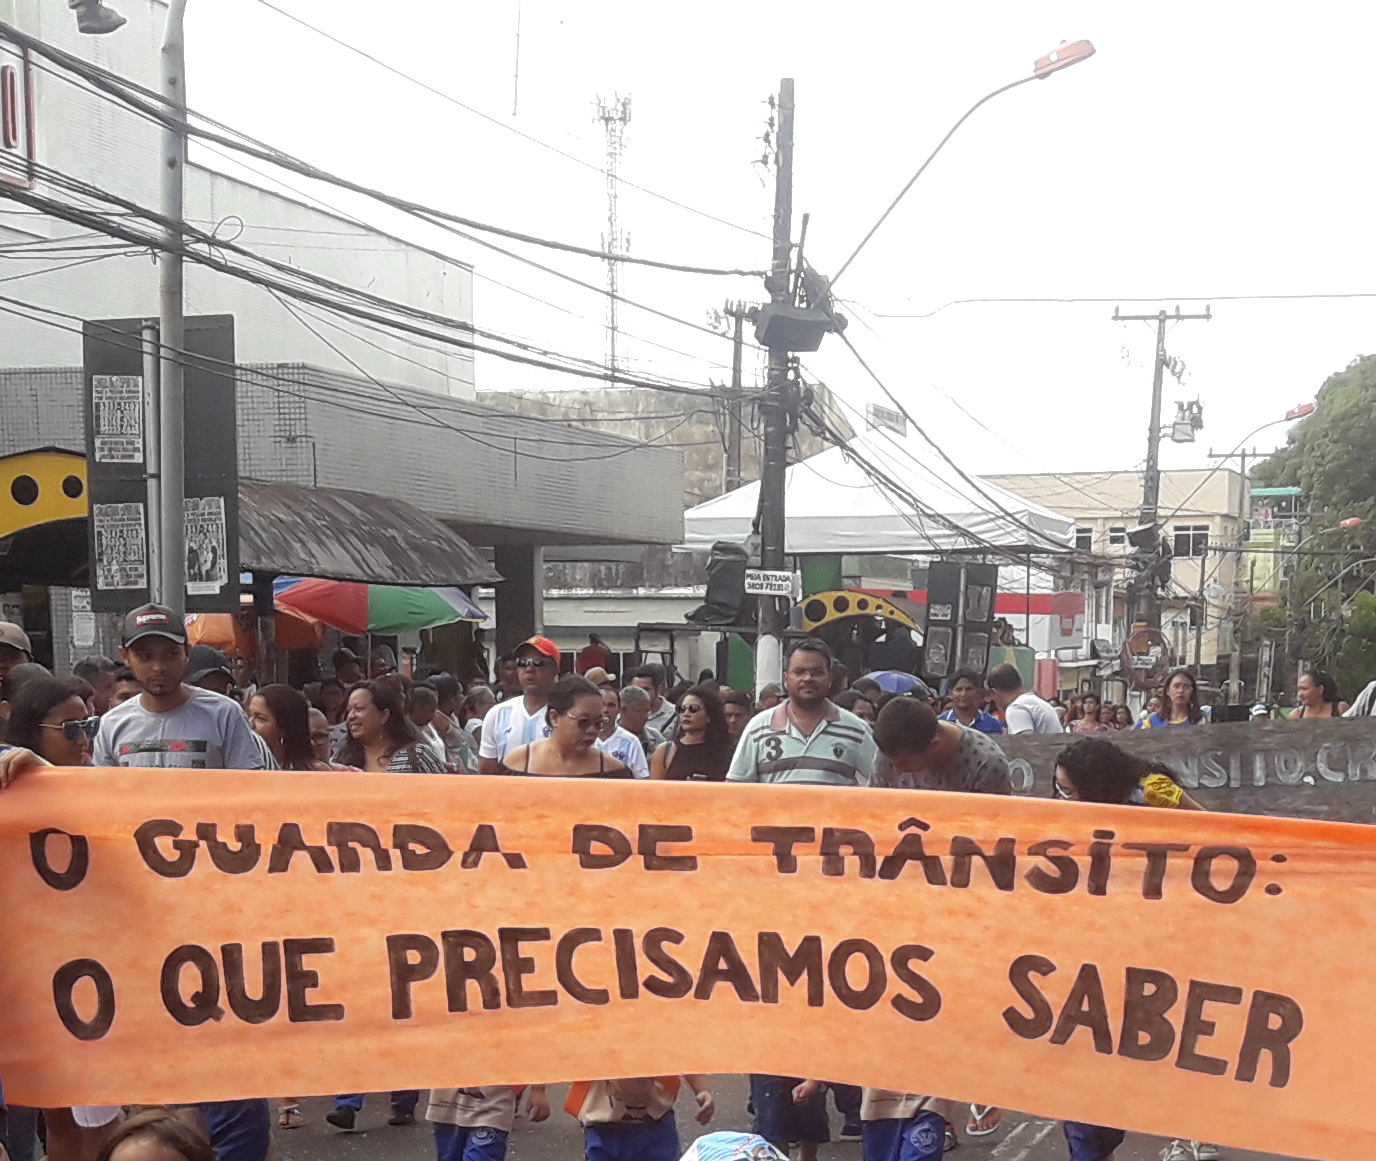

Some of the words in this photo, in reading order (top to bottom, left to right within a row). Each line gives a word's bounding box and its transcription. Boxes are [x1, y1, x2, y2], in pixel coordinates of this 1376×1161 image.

[765, 736, 784, 761] 3
[29, 827, 89, 891] O
[133, 818, 528, 878] GUARDA
[571, 823, 698, 872] DE
[750, 816, 1289, 904] TRÂNSITO:
[52, 958, 116, 1041] O
[160, 936, 345, 1026] QUE
[386, 926, 943, 1022] PRECISAMOS
[1001, 953, 1304, 1089] SABER
